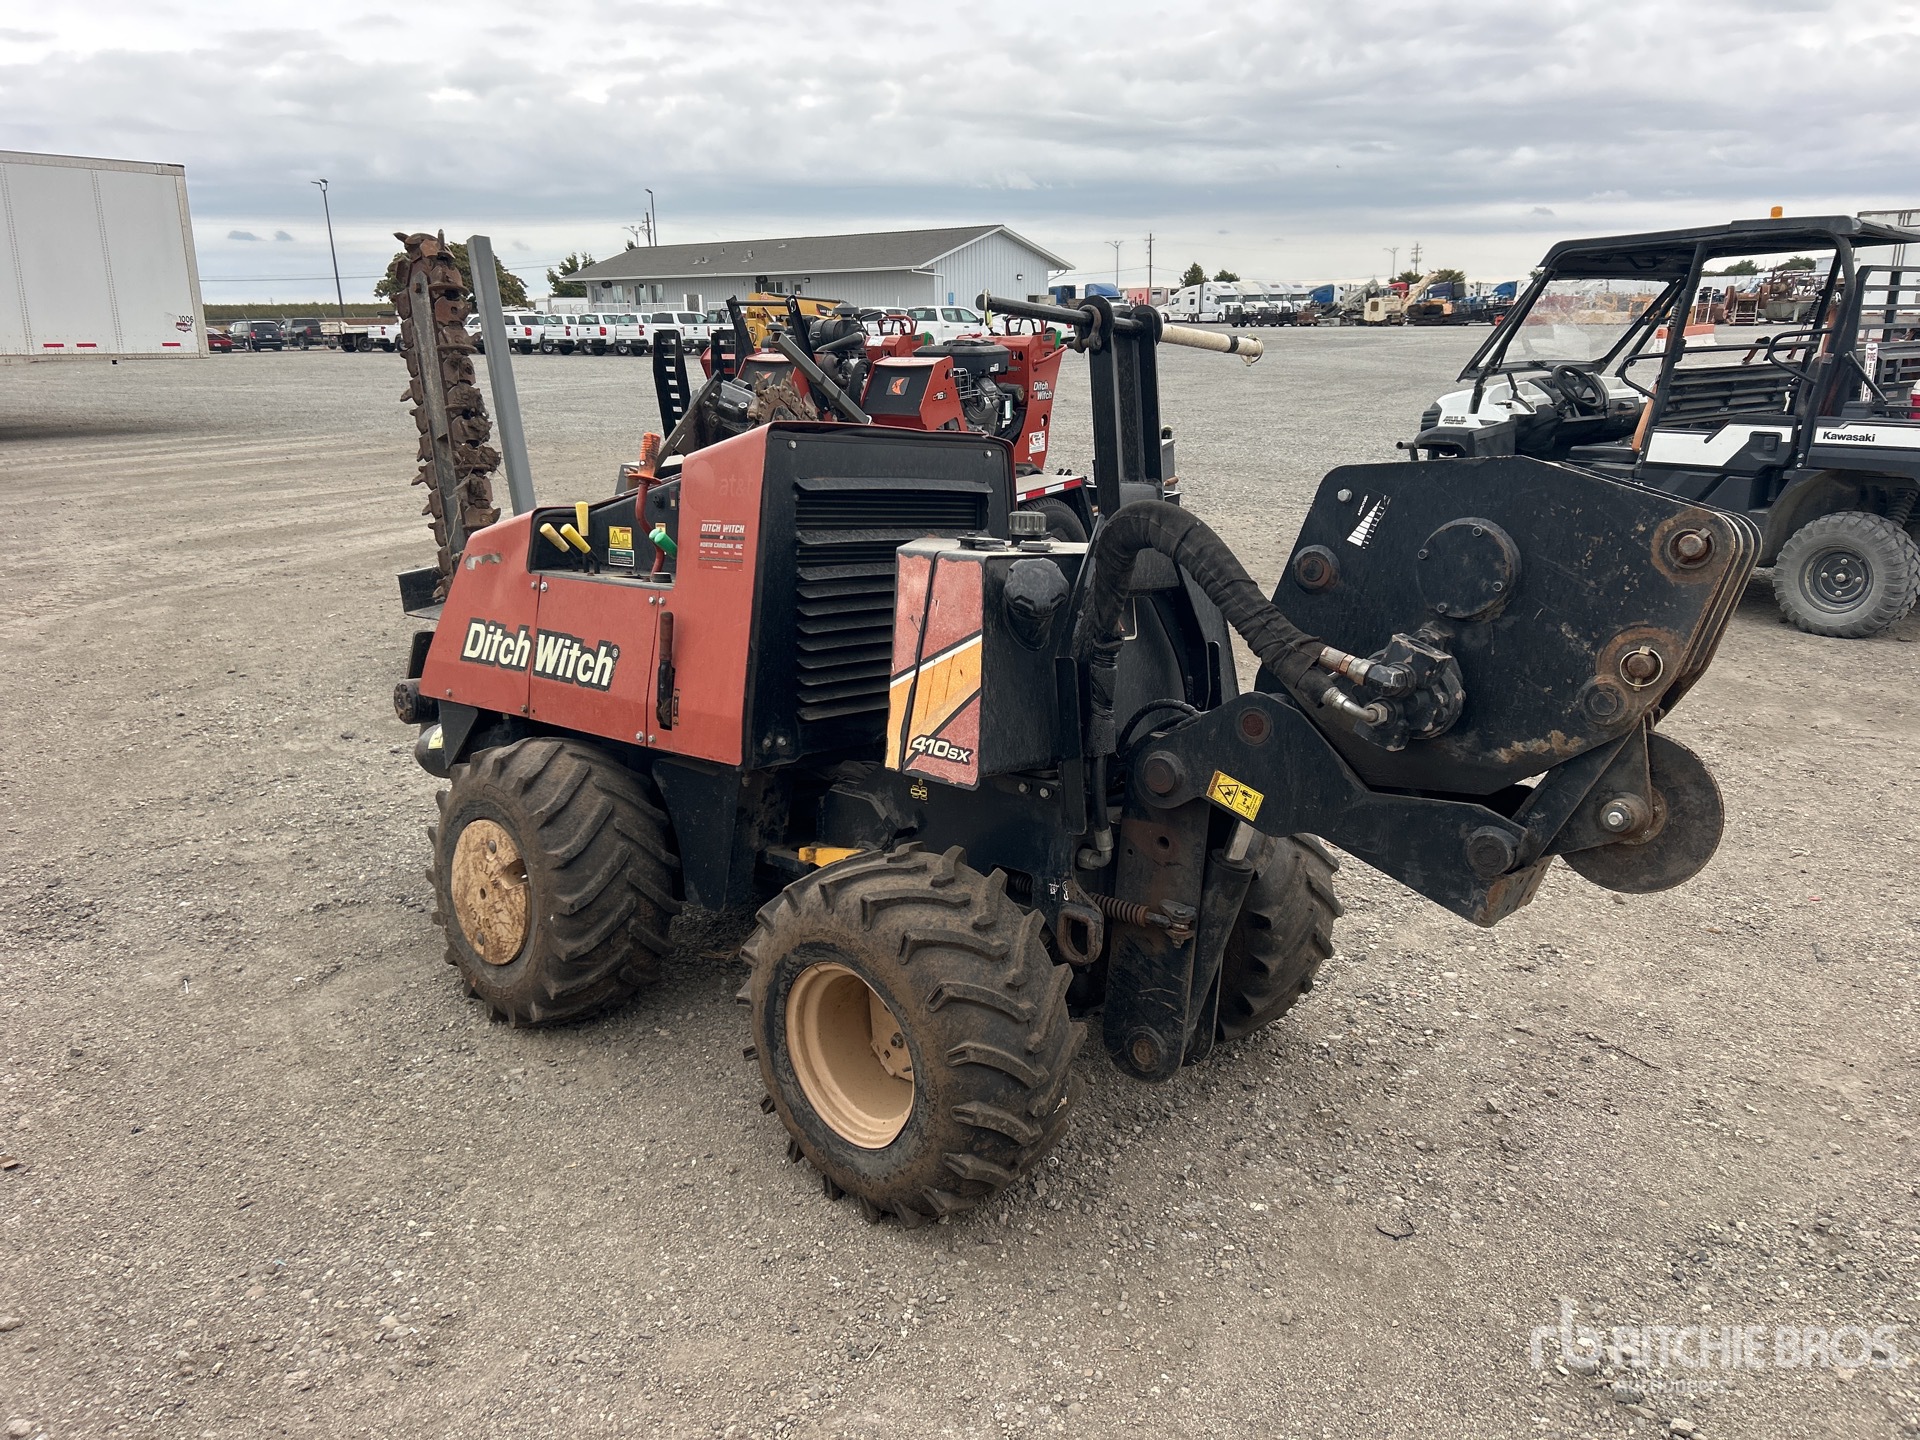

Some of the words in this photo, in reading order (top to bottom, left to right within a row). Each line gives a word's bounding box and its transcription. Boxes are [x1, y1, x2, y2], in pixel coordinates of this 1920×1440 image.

[1033, 380, 1049, 391] Ditch
[1037, 389, 1053, 400] Witch
[1822, 431, 1876, 442] Kawasaki
[701, 523, 721, 532] DITCH
[722, 524, 745, 533] WITCH
[463, 622, 531, 668] Ditch
